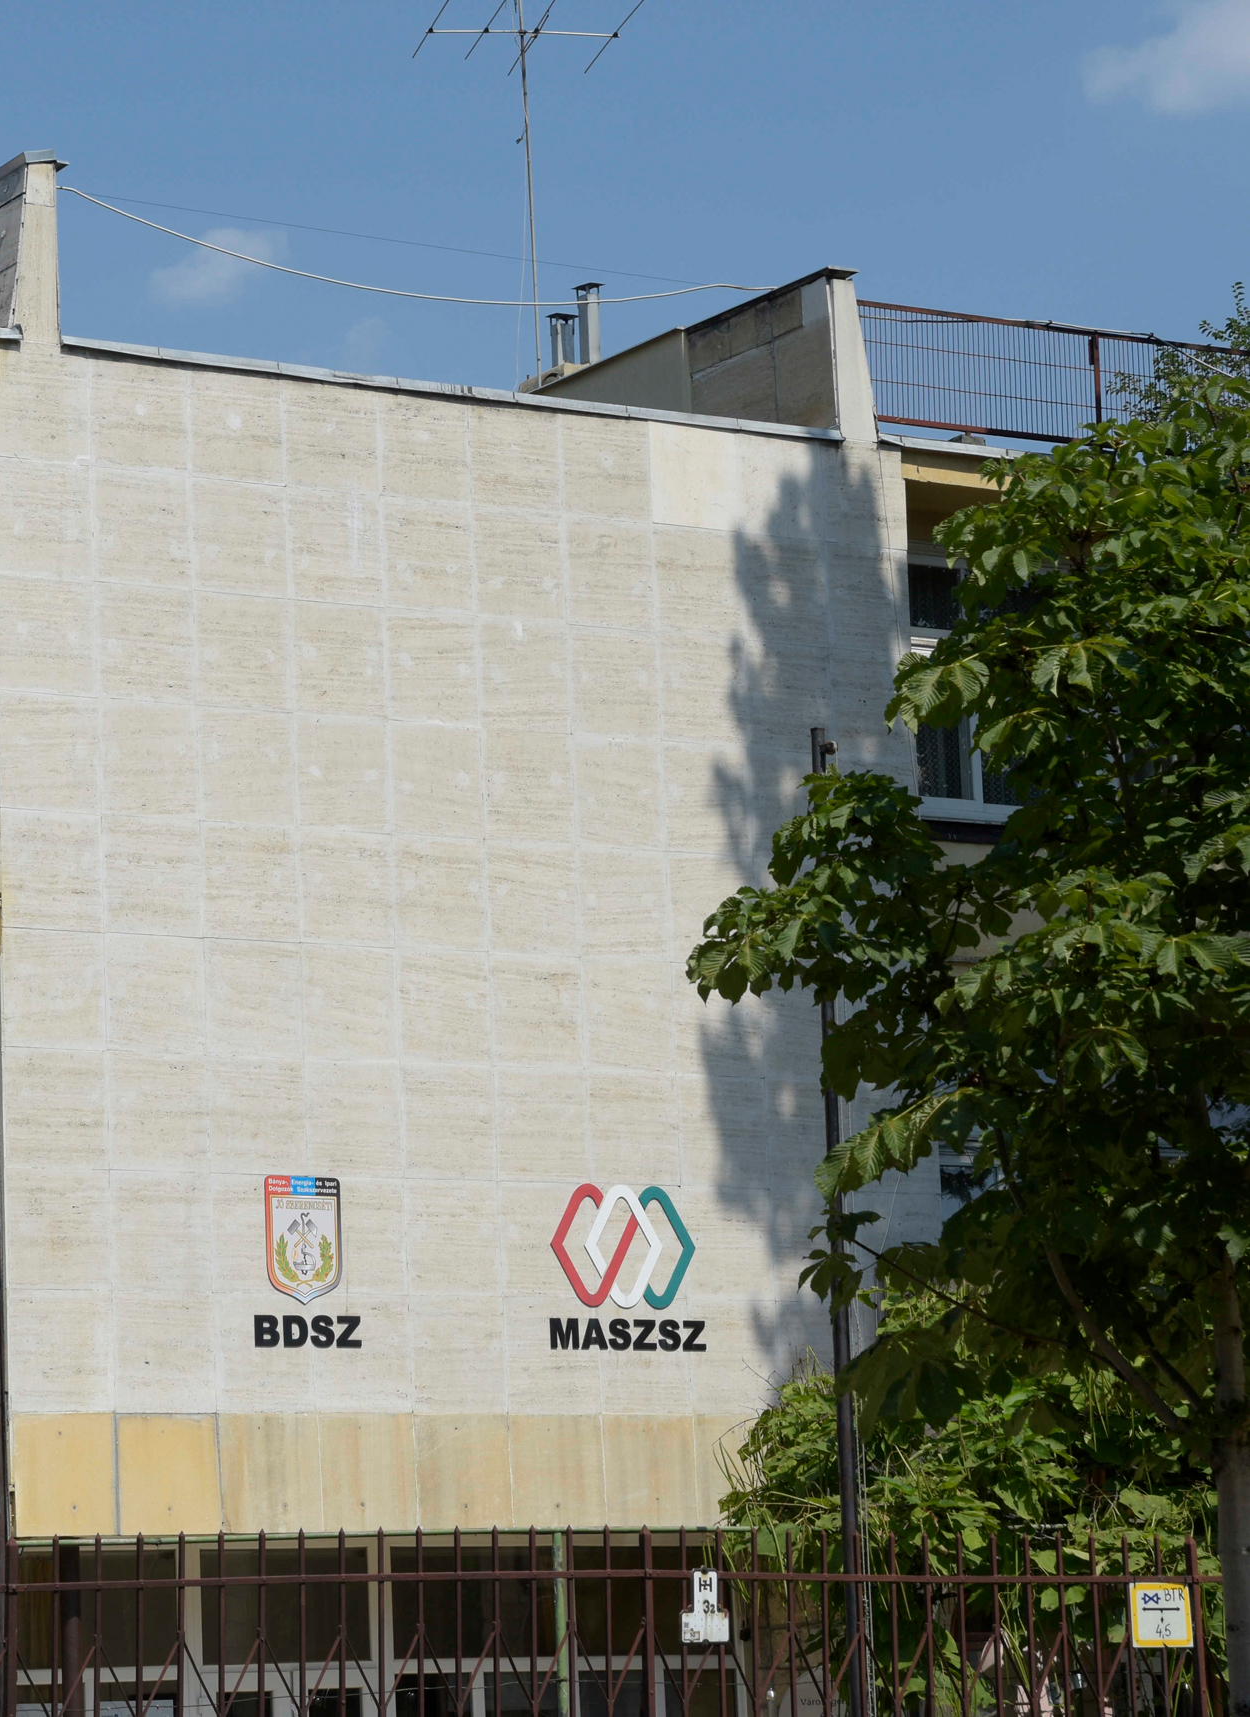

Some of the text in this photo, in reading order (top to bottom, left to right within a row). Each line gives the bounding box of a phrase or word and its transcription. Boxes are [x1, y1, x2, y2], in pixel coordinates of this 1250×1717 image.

[296, 1186, 338, 1194] Szakszervezete
[254, 1315, 362, 1348] BDSZ
[550, 1318, 707, 1351] MASZSZ
[1163, 1587, 1186, 1602] BTR
